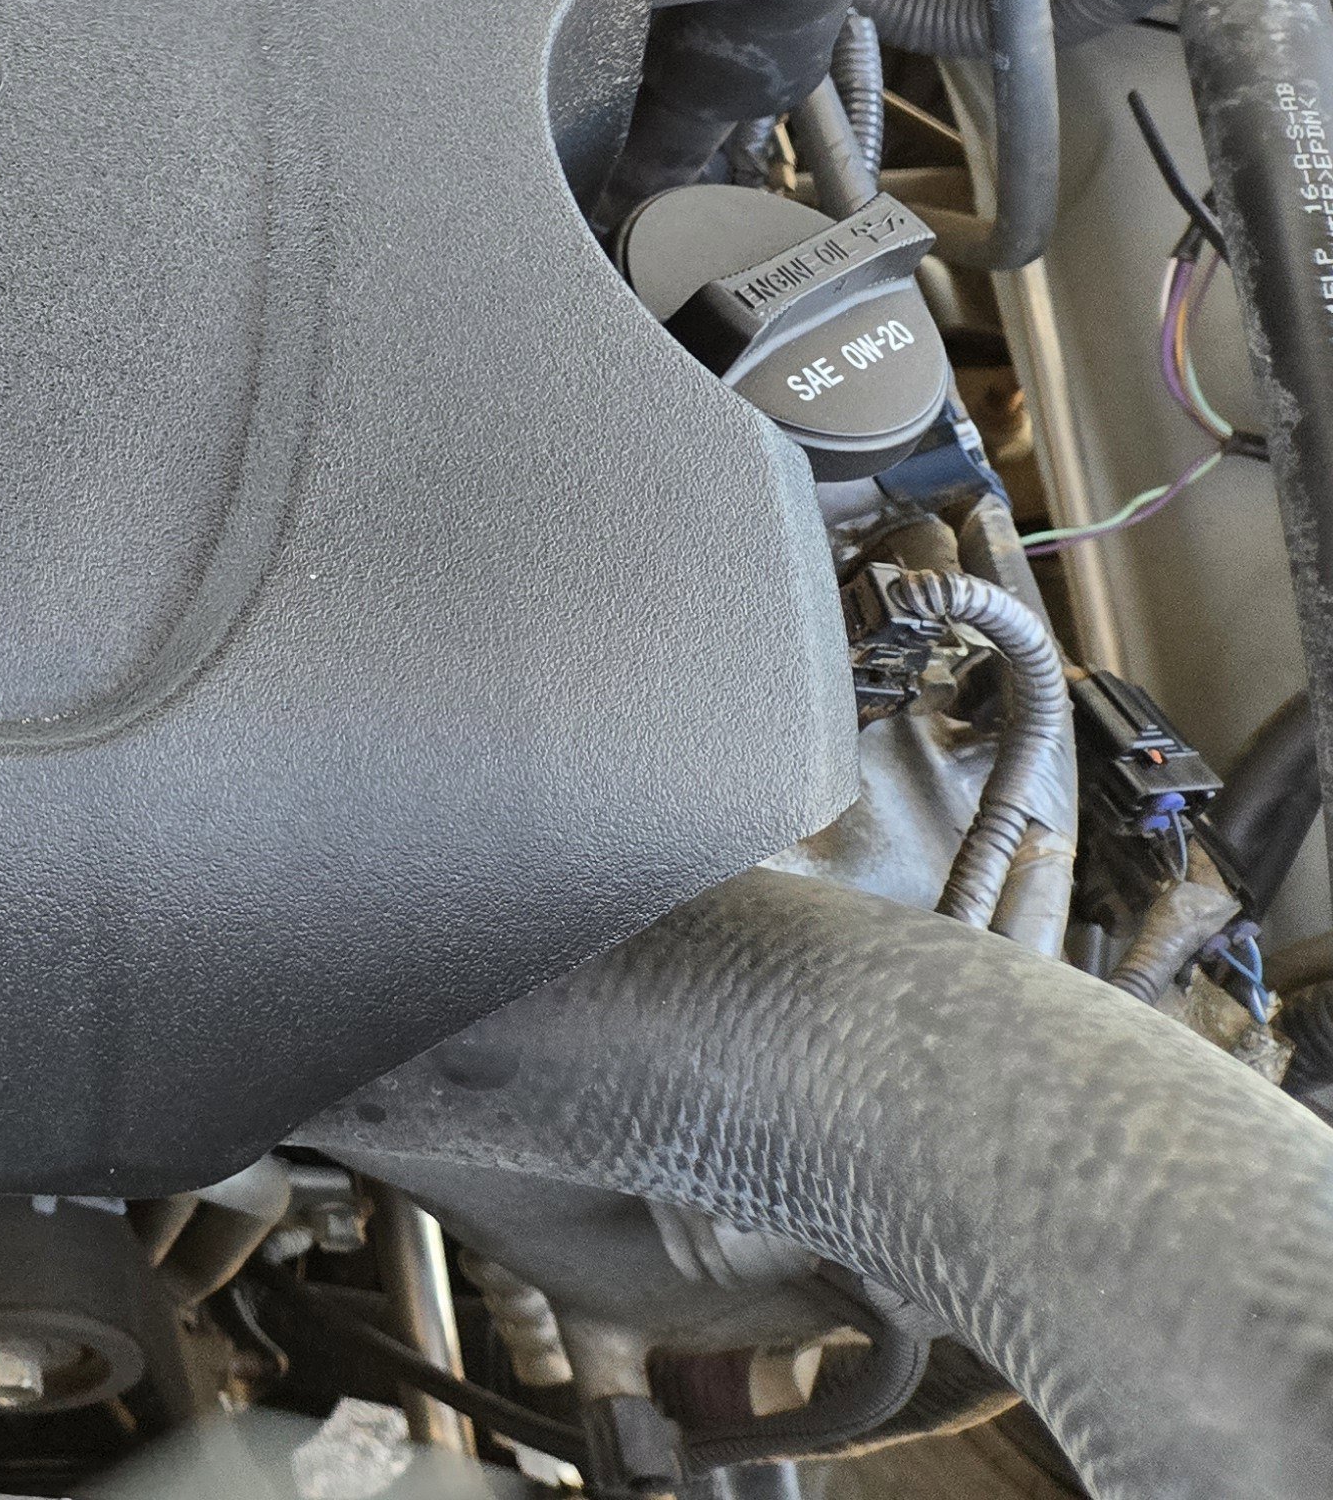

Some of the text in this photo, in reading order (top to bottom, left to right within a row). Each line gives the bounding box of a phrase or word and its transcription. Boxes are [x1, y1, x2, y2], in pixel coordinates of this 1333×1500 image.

[1275, 81, 1323, 214] 16-A-S-AB
[734, 238, 860, 310] ENGINE OIL
[786, 319, 915, 401] SAE 0W-20
